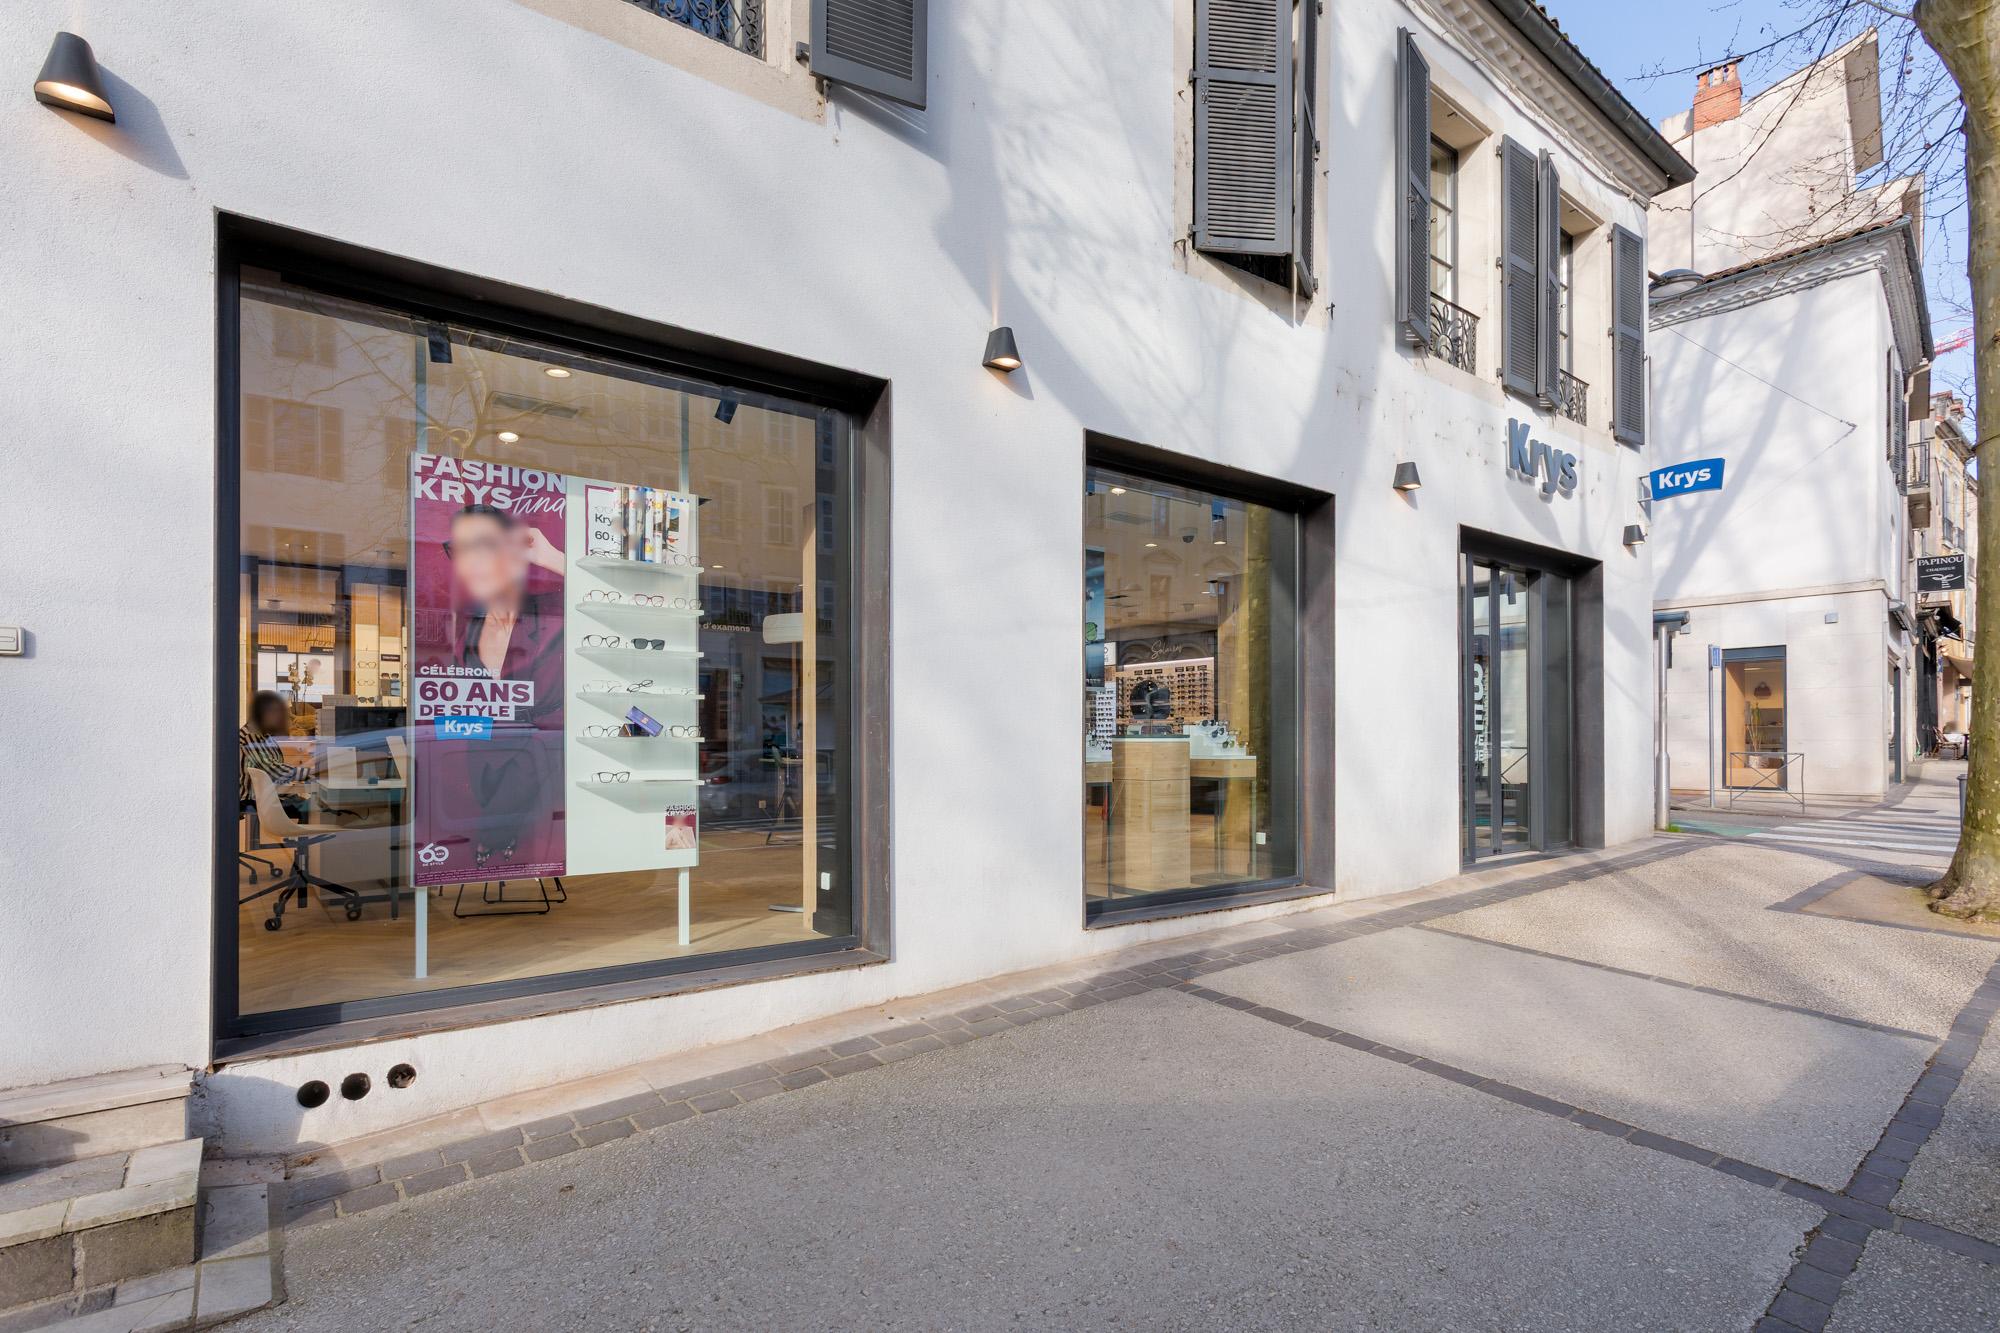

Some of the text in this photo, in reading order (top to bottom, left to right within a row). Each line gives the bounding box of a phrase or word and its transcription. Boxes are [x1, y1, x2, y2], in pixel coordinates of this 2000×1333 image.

[1508, 418, 1577, 494] Krys
[415, 452, 567, 494] FASHION
[1658, 467, 1711, 489] Krys
[594, 513, 612, 526] Kry
[594, 531, 610, 541] 60
[1918, 556, 1964, 567] PAPINOU
[419, 681, 531, 704] 60 ANS
[420, 704, 510, 718] DE STYLE
[444, 719, 484, 735] Krys
